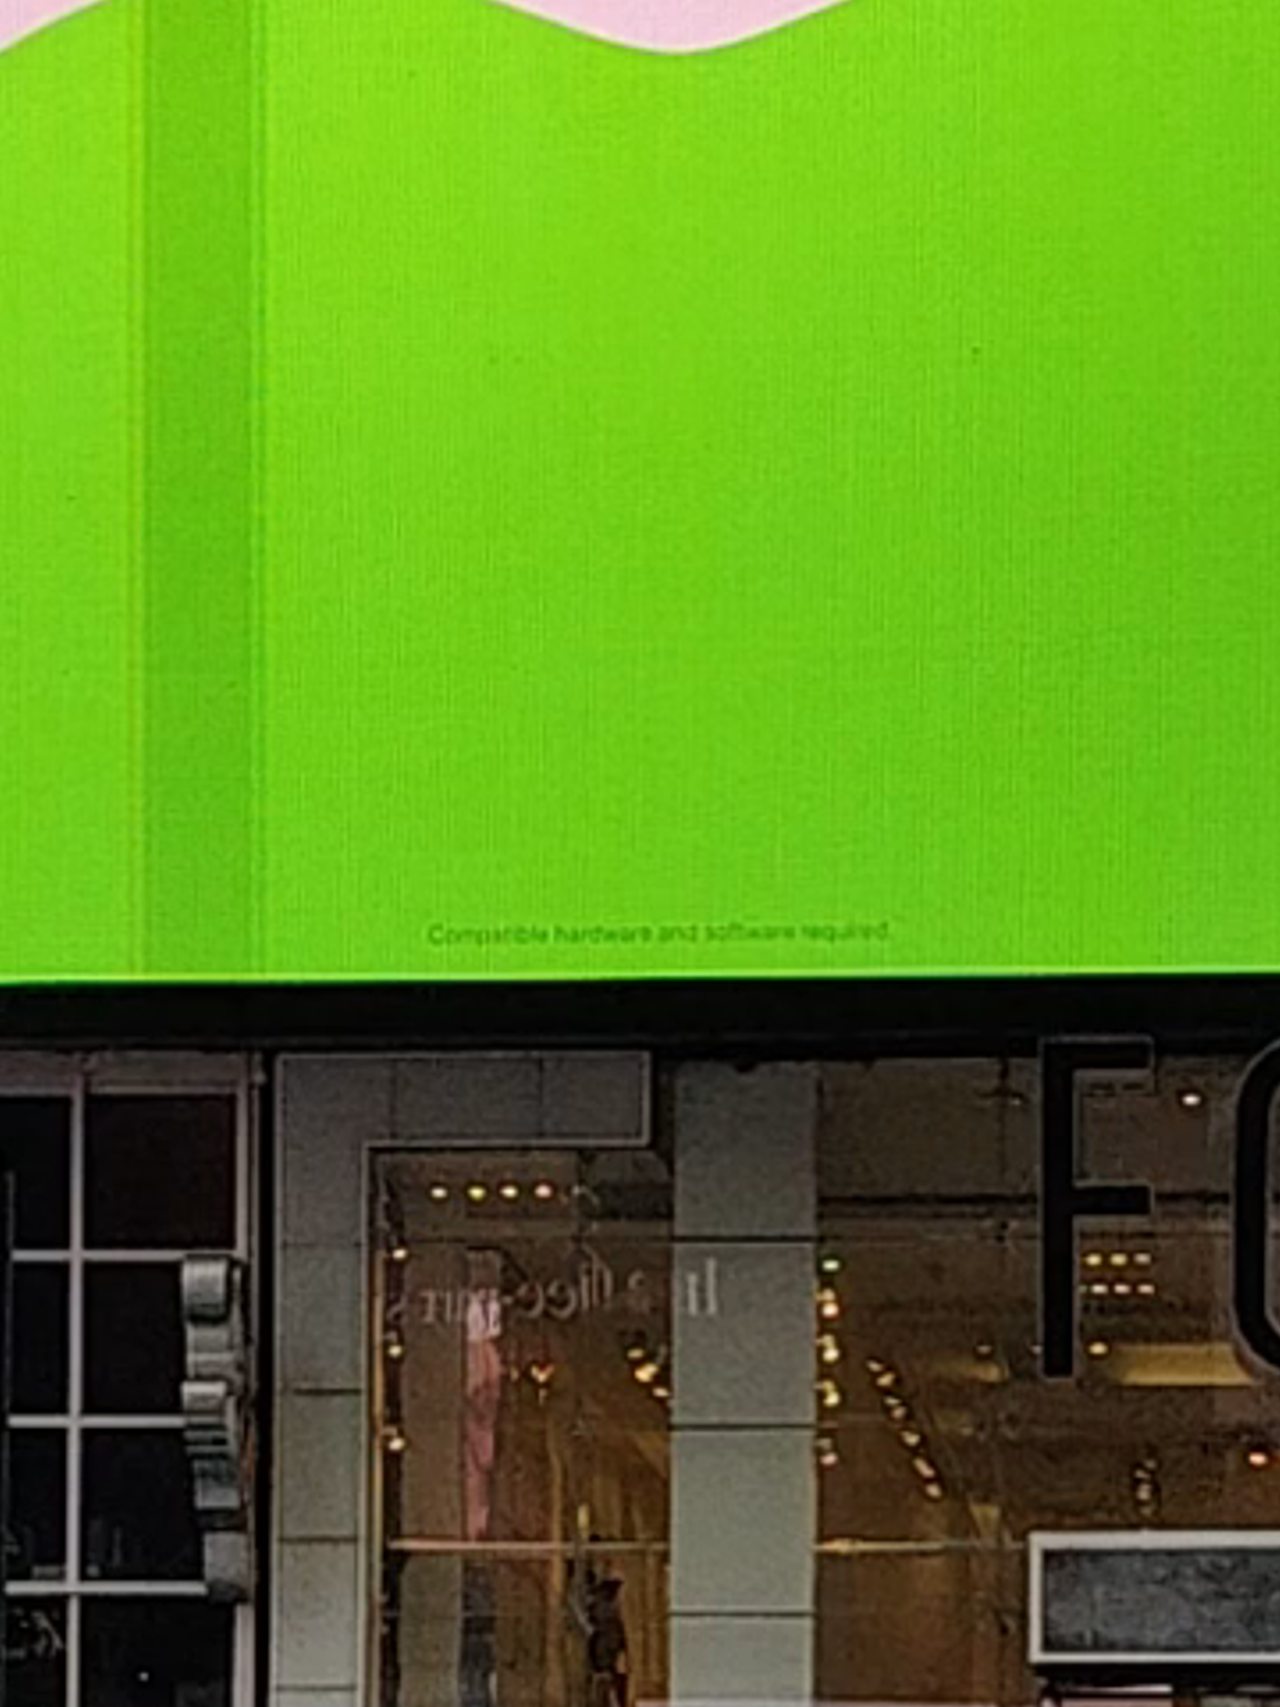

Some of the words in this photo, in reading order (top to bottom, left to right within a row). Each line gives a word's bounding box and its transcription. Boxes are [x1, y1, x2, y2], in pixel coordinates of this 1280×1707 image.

[427, 921, 549, 948] Compatible
[552, 920, 652, 943] hardware
[657, 921, 697, 943] and
[705, 918, 796, 943] software
